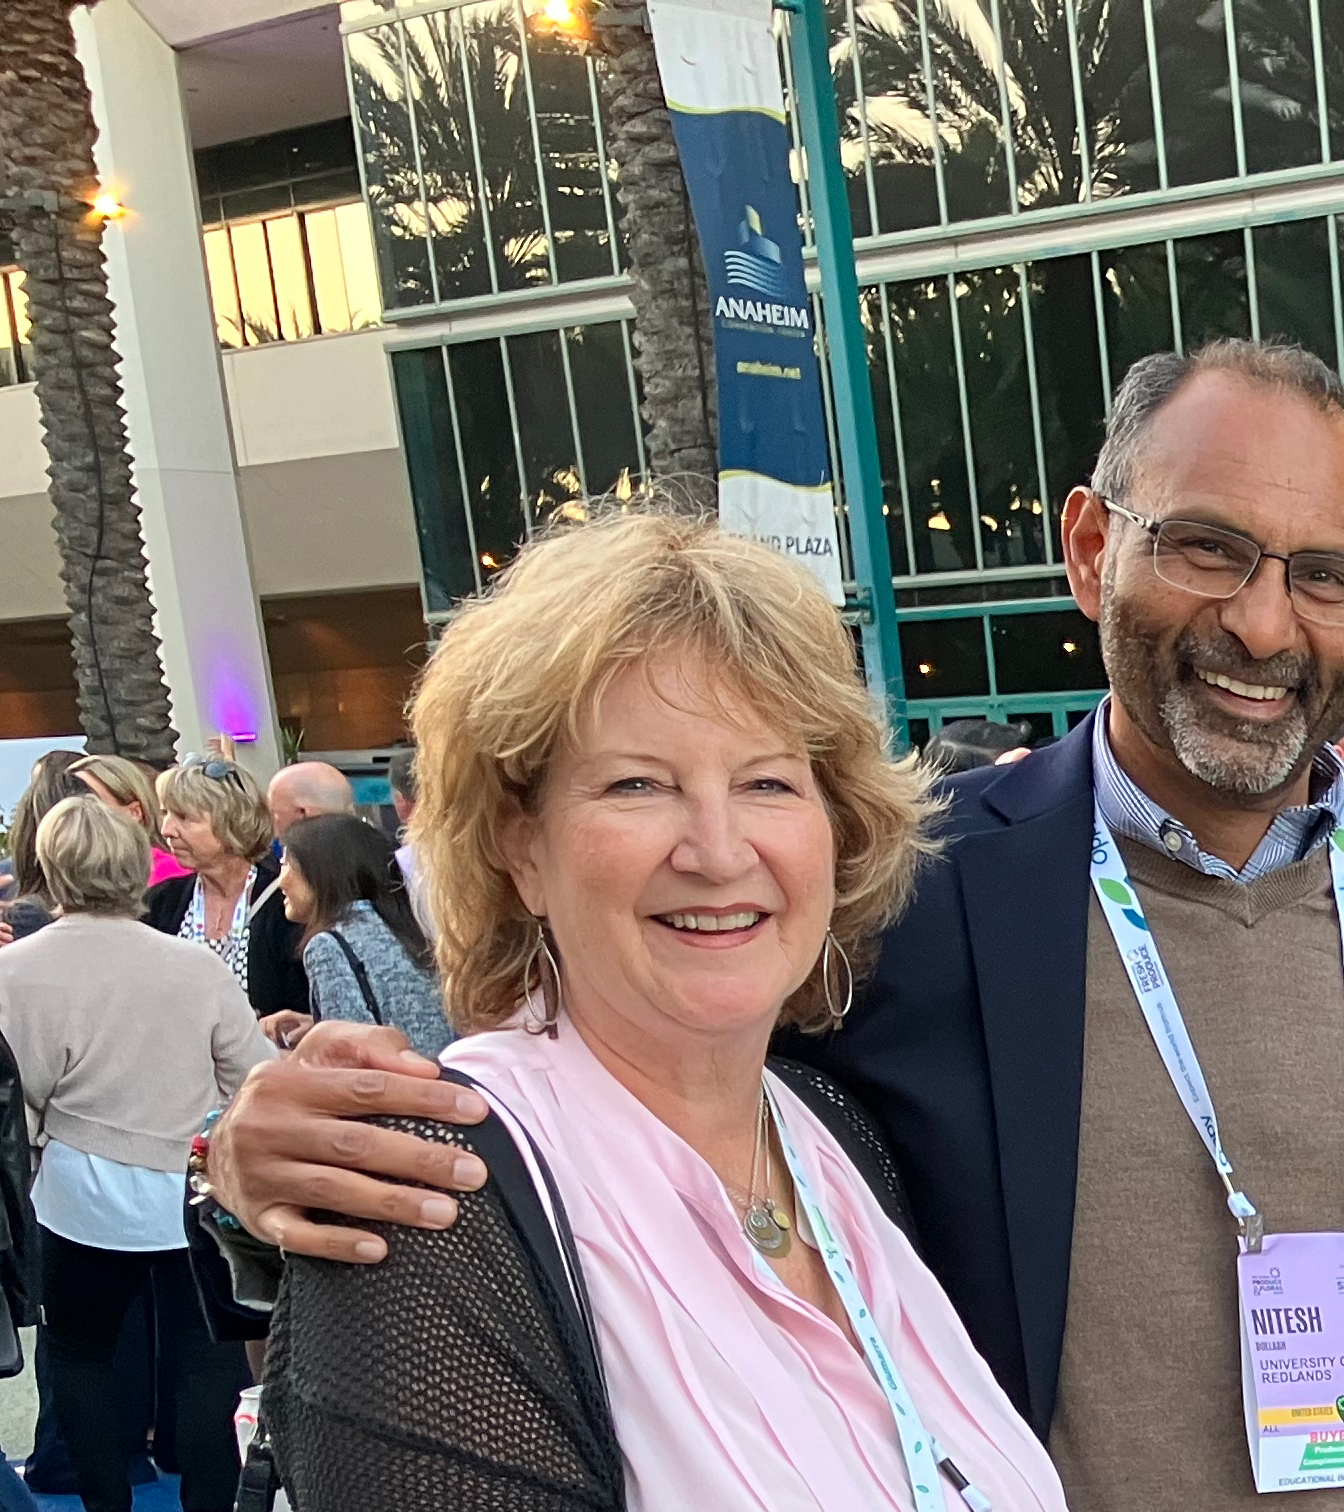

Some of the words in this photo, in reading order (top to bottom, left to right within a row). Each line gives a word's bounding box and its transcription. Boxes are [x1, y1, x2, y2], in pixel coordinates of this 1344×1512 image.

[715, 296, 808, 329] ANAHEIM
[786, 535, 833, 557] PLAZA
[1251, 1306, 1323, 1336] NITESH
[1260, 1356, 1336, 1371] UNIVERSITY
[1262, 1370, 1332, 1384] REDLANDS
